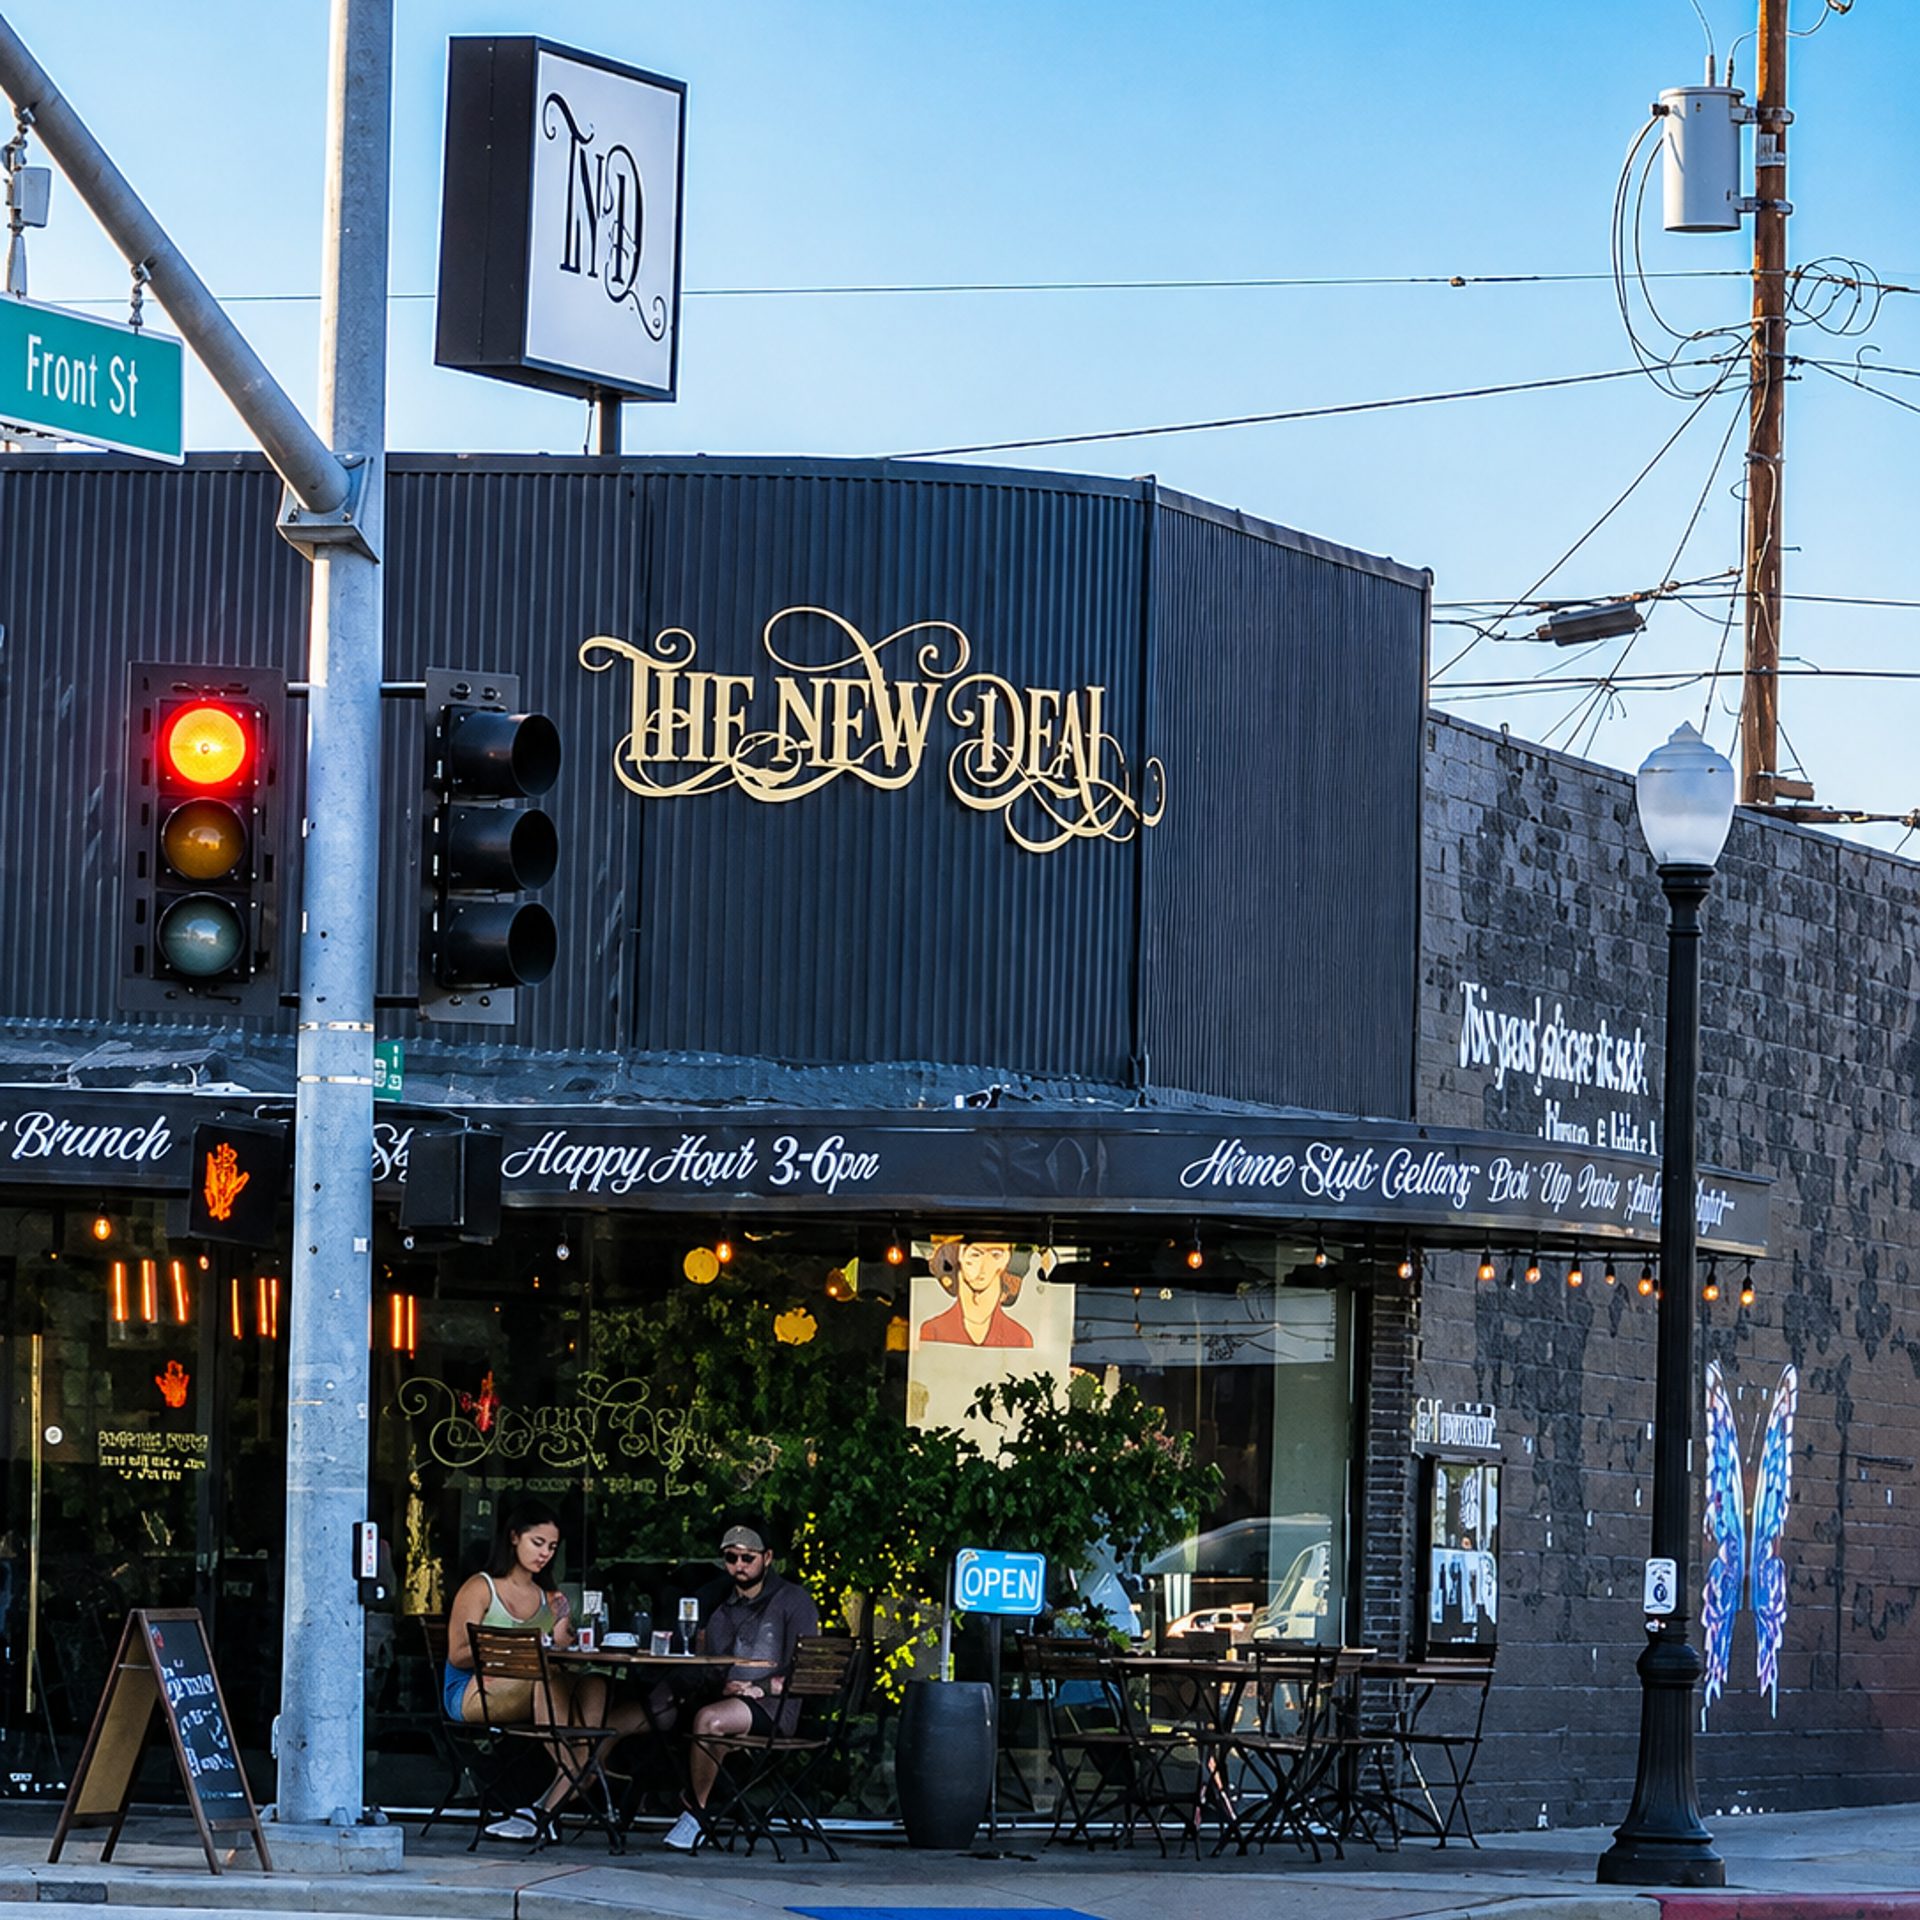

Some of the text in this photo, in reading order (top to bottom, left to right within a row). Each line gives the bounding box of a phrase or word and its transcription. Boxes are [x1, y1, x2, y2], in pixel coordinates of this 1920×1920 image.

[26, 335, 138, 419] Front St
[579, 605, 1166, 854] THE NEW DEAL
[11, 1111, 172, 1160] Brunch
[501, 1130, 652, 1194] Happy
[649, 1133, 759, 1187] Hour
[965, 1567, 1037, 1600] OPEN
